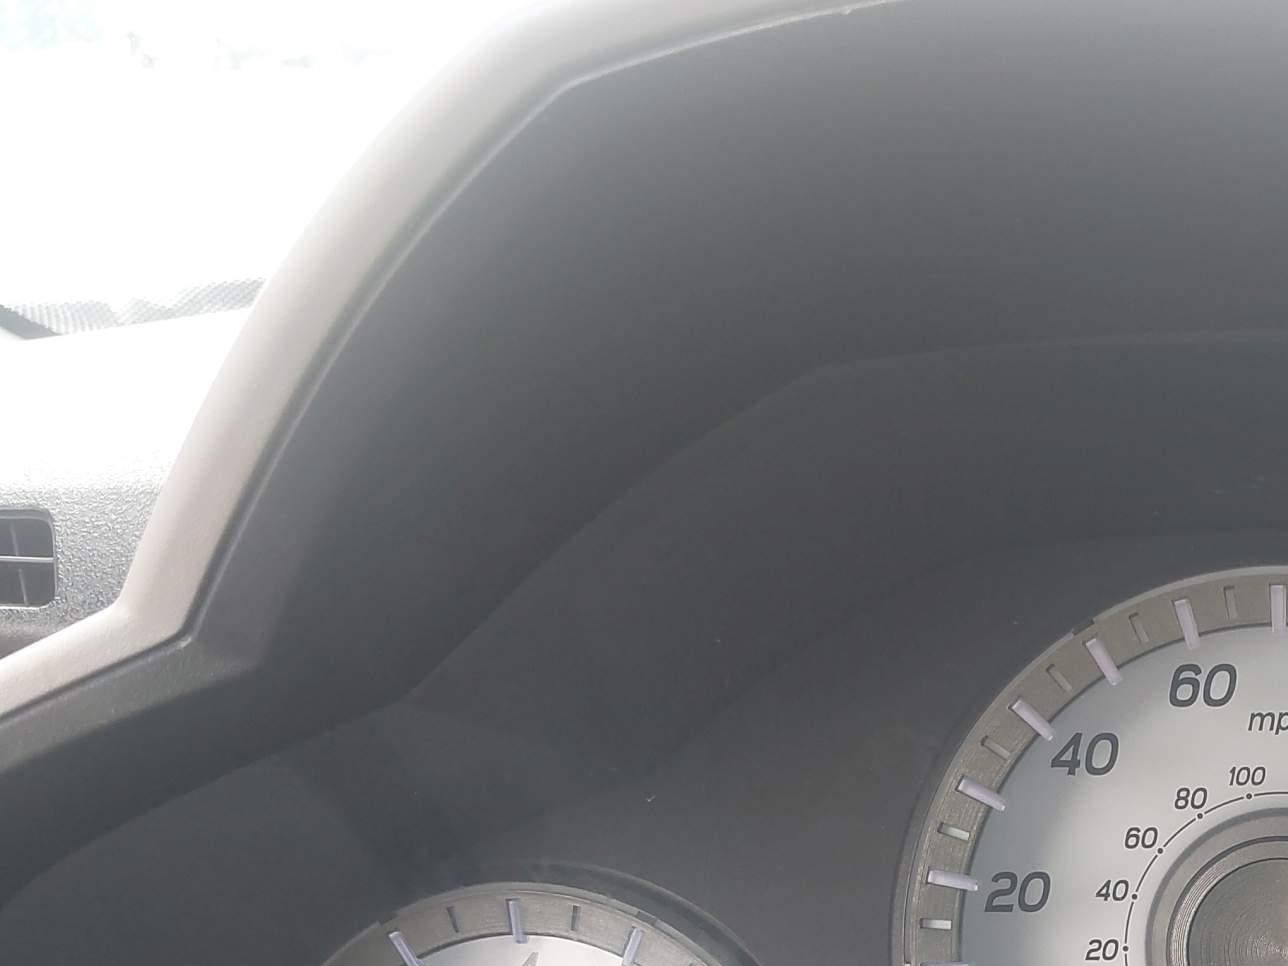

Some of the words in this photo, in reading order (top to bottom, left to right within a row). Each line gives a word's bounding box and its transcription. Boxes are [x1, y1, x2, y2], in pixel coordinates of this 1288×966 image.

[1168, 663, 1238, 708] 60
[1050, 732, 1119, 776] 40
[1228, 766, 1266, 786] 100
[1174, 787, 1208, 810] 80
[1124, 827, 1158, 849] 60
[983, 871, 1051, 913] 20
[1095, 879, 1129, 901] 40
[1085, 938, 1119, 961] 20
